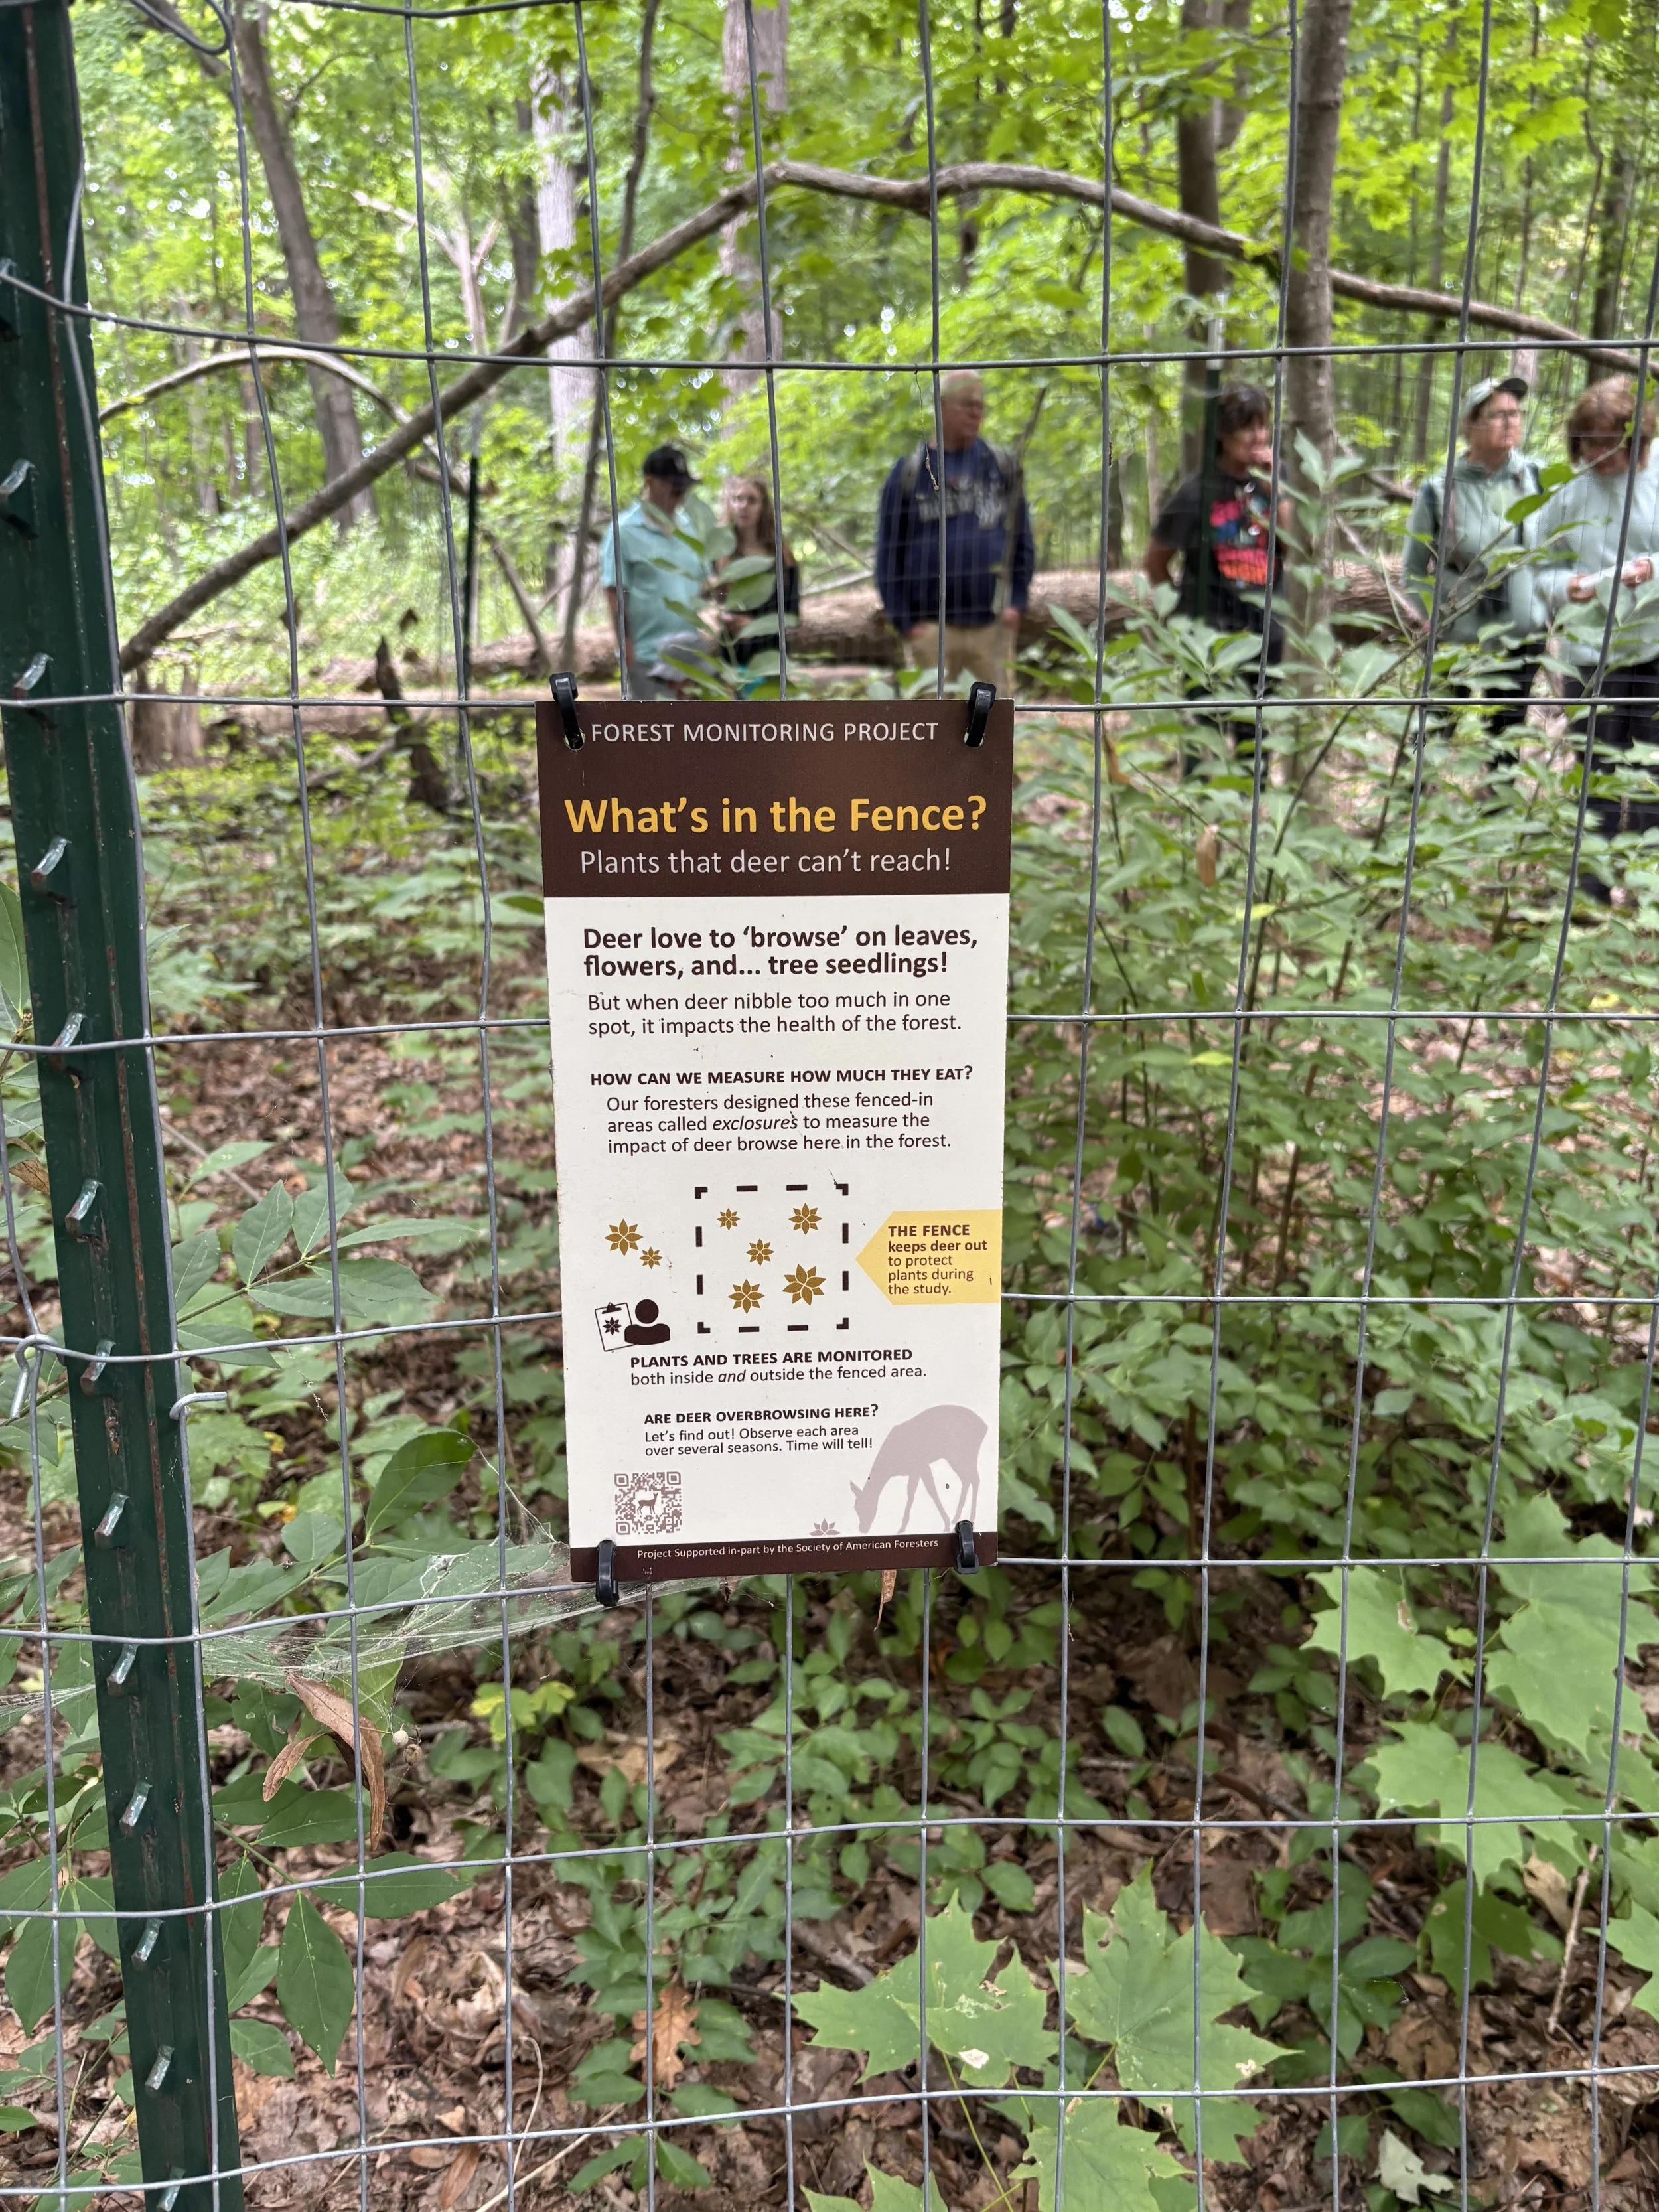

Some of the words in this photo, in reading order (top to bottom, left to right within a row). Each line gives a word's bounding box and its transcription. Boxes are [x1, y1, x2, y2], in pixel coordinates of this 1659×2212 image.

[592, 723, 675, 742] FOREST
[684, 723, 834, 742] MONITORING
[845, 722, 939, 741] PROJECT
[722, 798, 757, 832] in
[770, 796, 836, 832] the
[851, 795, 987, 832] Fence?
[581, 849, 660, 873] Plants
[668, 849, 722, 873] that
[731, 849, 790, 873] deer
[871, 848, 950, 871] reach!
[584, 928, 643, 949] Deer
[651, 926, 702, 949] love
[709, 929, 735, 948] to
[855, 930, 886, 947] on
[895, 924, 977, 949] leaves,
[583, 954, 684, 980] flowers,
[691, 954, 760, 976] and...
[768, 956, 818, 975] tree
[826, 951, 947, 978] seedlings!
[589, 995, 620, 1011] But
[626, 993, 678, 1011] when
[685, 993, 729, 1010] deer
[735, 992, 792, 1009] nibble
[798, 994, 830, 1009] too
[835, 992, 886, 1008] much
[893, 992, 909, 1007] in
[915, 994, 950, 1007] one
[589, 1019, 635, 1037] spot,
[642, 1018, 655, 1034] it
[660, 1017, 734, 1037] impacts
[739, 1016, 770, 1033] the
[777, 1015, 835, 1033] health
[841, 1014, 861, 1031] of
[865, 1014, 897, 1031] the
[902, 1014, 961, 1031] forest.
[591, 1073, 632, 1086] HOW
[637, 1072, 670, 1085] CAN
[676, 1072, 702, 1084] WE
[707, 1071, 785, 1084] MEASURE
[790, 1070, 831, 1083] HOW
[837, 1069, 885, 1082] MUCH
[891, 1069, 931, 1081] THEY
[936, 1065, 973, 1080] EAT?
[607, 1097, 639, 1112] Our
[644, 1095, 719, 1111] foresters
[723, 1093, 798, 1112] designed
[804, 1093, 850, 1108] these
[855, 1092, 933, 1107] fenced-in
[607, 1120, 653, 1132] areas
[658, 1116, 707, 1132] called
[713, 1115, 798, 1131] exclosures
[802, 1116, 820, 1129] to
[826, 1116, 897, 1128] measure
[902, 1113, 930, 1127] the
[609, 1139, 666, 1156] impact
[672, 1137, 689, 1152] of
[693, 1137, 733, 1152] deer
[737, 1136, 798, 1151] browse
[804, 1135, 841, 1150] here
[846, 1134, 860, 1149] in
[865, 1134, 893, 1149] the
[898, 1133, 951, 1148] forest.
[888, 1225, 917, 1238] THE
[922, 1224, 970, 1237] FENCE
[888, 1241, 926, 1254] keeps
[930, 1240, 961, 1252] deer
[964, 1240, 987, 1251] out
[888, 1256, 902, 1267] to
[906, 1254, 953, 1269] protect
[889, 1270, 928, 1284] plants
[932, 1269, 974, 1282] during
[888, 1284, 910, 1295] the
[913, 1283, 952, 1296] study.
[630, 1355, 689, 1368] PLANTS
[693, 1354, 728, 1366] AND
[732, 1352, 778, 1365] TREES
[782, 1351, 812, 1363] ARE
[818, 1349, 912, 1363] MONITORED
[631, 1372, 665, 1386] both
[670, 1370, 713, 1384] inside
[718, 1369, 747, 1383] and
[750, 1367, 804, 1382] outside
[808, 1366, 833, 1380] the
[837, 1364, 886, 1379] fenced
[891, 1367, 926, 1378] area.
[644, 1413, 672, 1424] ARE
[676, 1412, 711, 1424] DEER
[716, 1408, 830, 1422] OVERBROWSING
[835, 1403, 879, 1418] HERE?
[678, 1429, 703, 1441] find
[708, 1428, 735, 1440] out!
[739, 1427, 792, 1439] Observe
[796, 1425, 826, 1437] each
[831, 1427, 859, 1436] area
[645, 1447, 674, 1457] over
[678, 1442, 723, 1455] several
[727, 1443, 782, 1453] seasons.
[786, 1439, 818, 1451] Time
[822, 1438, 843, 1450] will
[847, 1437, 873, 1449] tell!
[637, 1550, 672, 1560] Project
[674, 1546, 725, 1558] Supported
[728, 1546, 760, 1556] in-part
[763, 1544, 775, 1555] by
[777, 1544, 794, 1553] the
[796, 1543, 831, 1553] Society
[833, 1542, 843, 1551] of
[845, 1540, 891, 1550] American
[894, 1540, 938, 1548] Foresters
